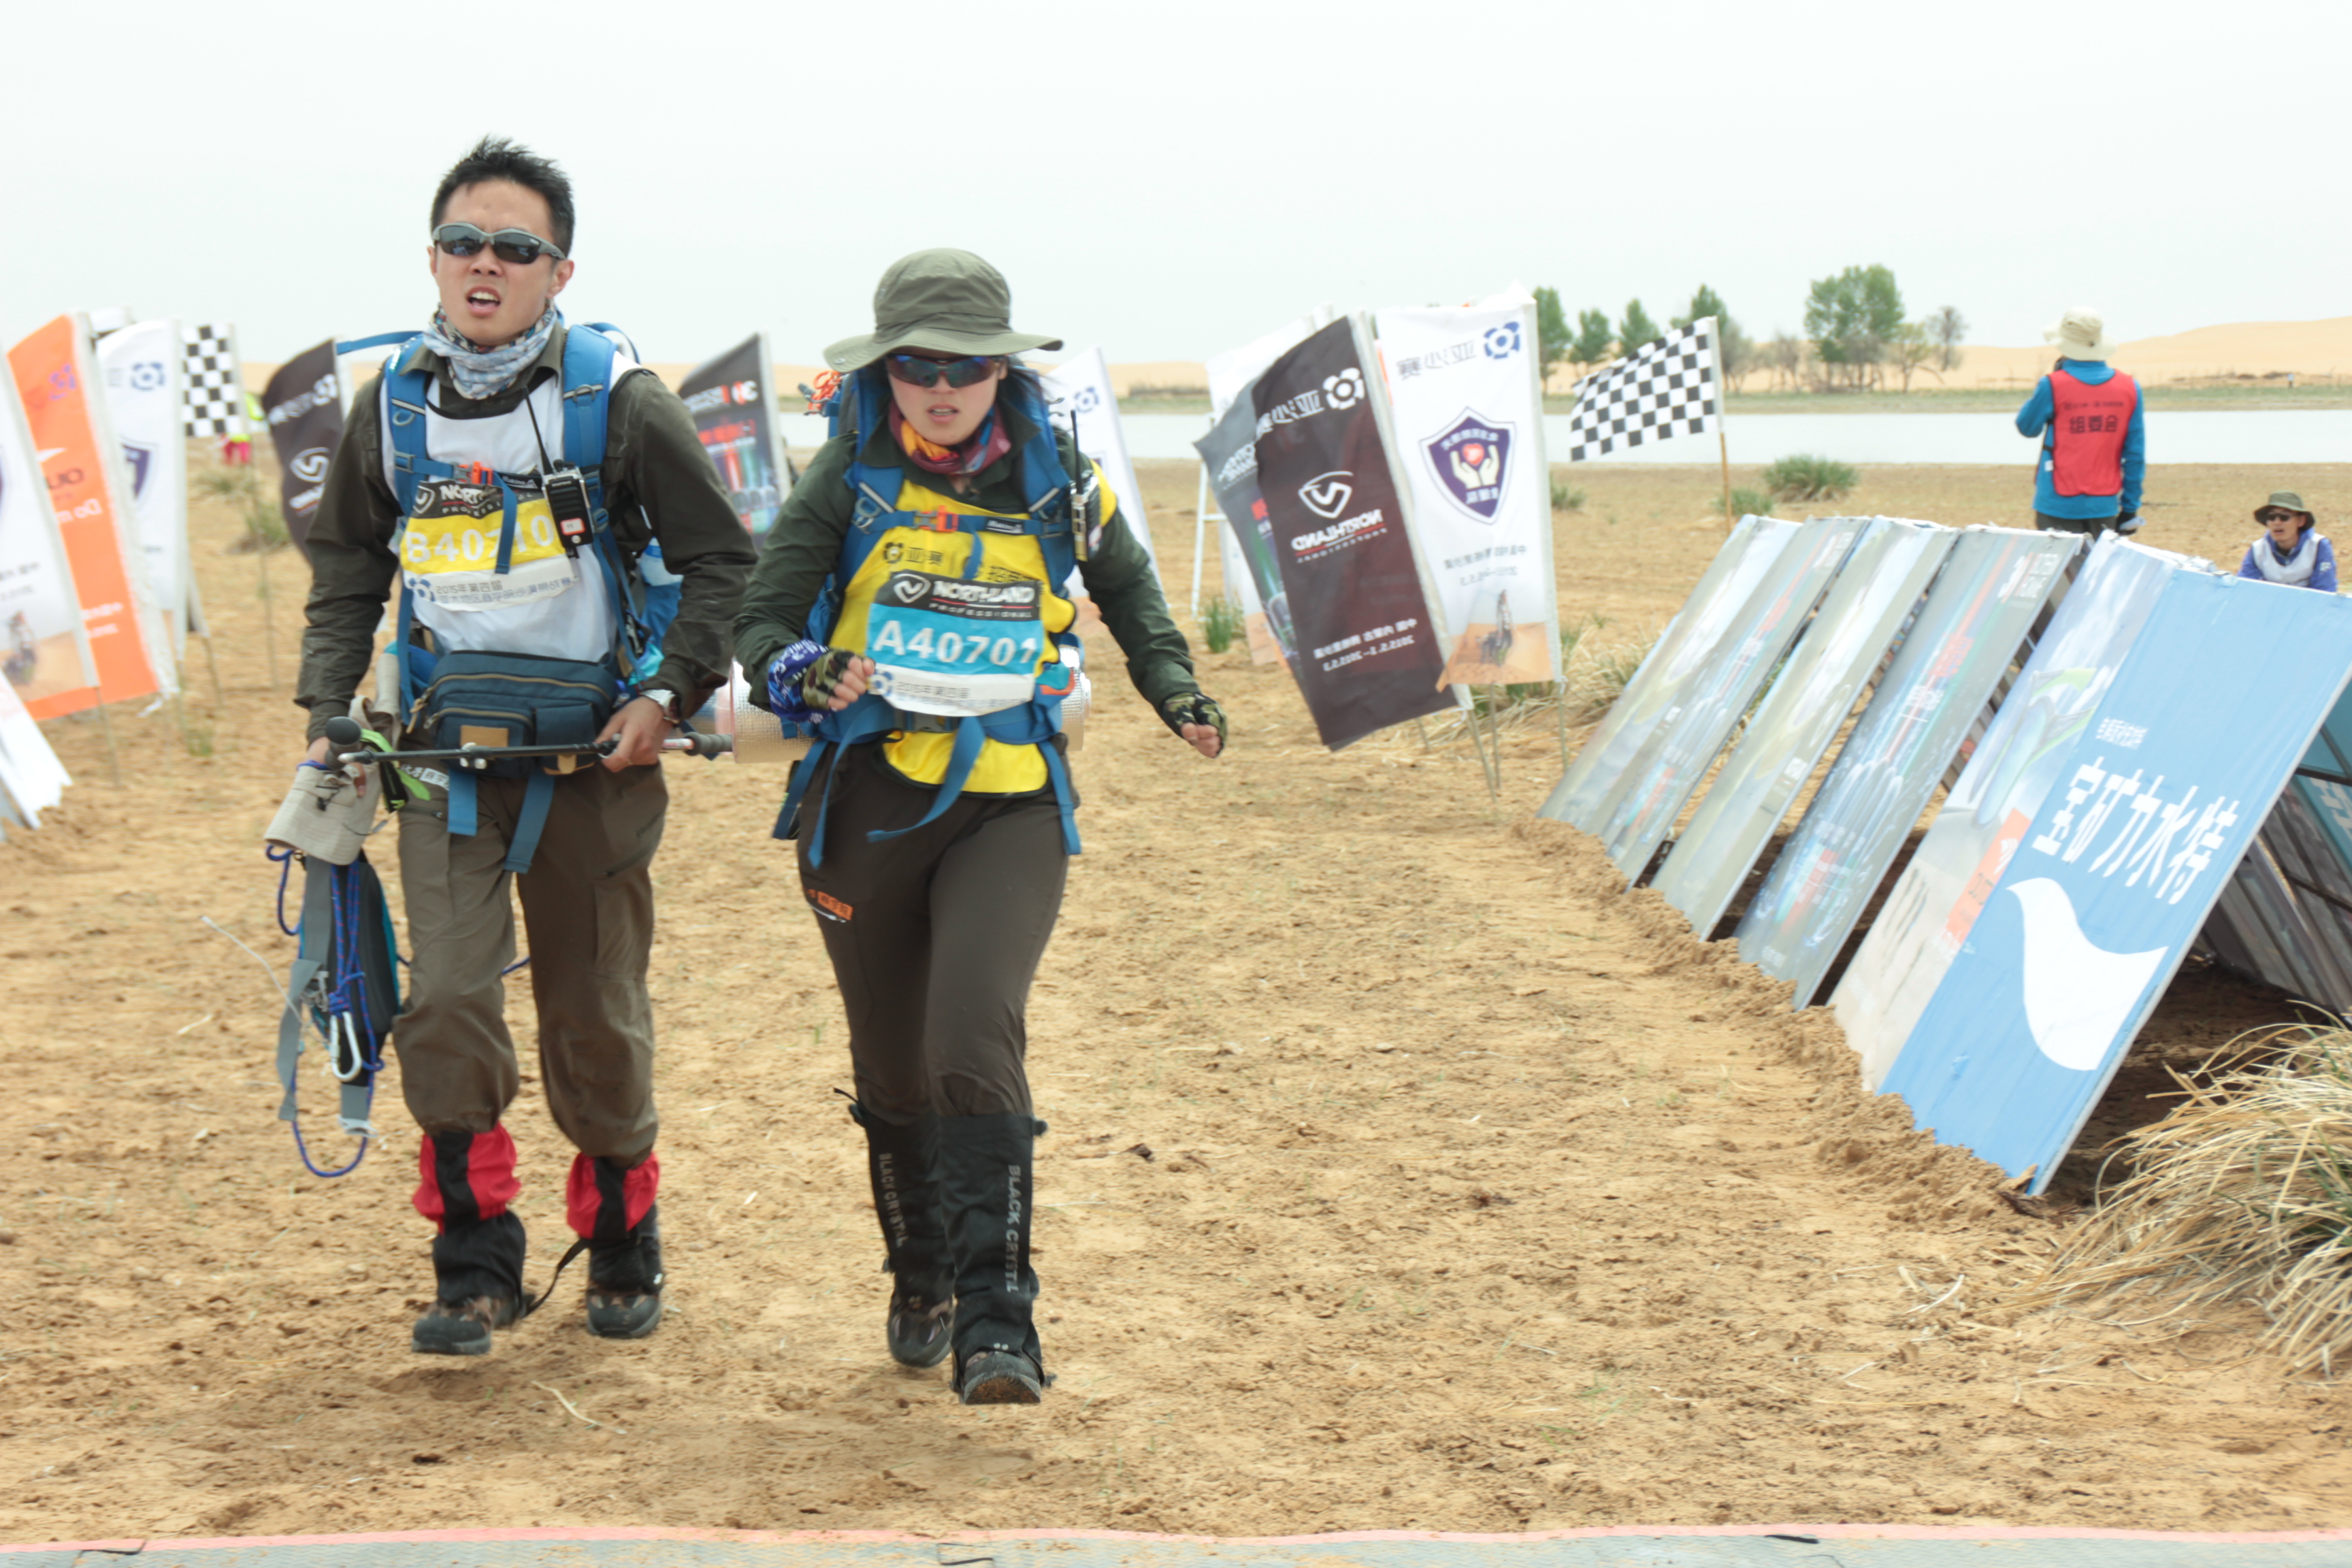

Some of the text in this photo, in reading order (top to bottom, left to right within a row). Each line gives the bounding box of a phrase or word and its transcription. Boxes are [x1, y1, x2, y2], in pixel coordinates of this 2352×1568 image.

[928, 602, 1033, 618] PROFESSIONAL
[932, 581, 1036, 604] NORTHLAND
[872, 620, 1036, 666] A40701
[2031, 756, 2240, 904] 宝矿力水特
[1006, 1164, 1022, 1225] BLACK
